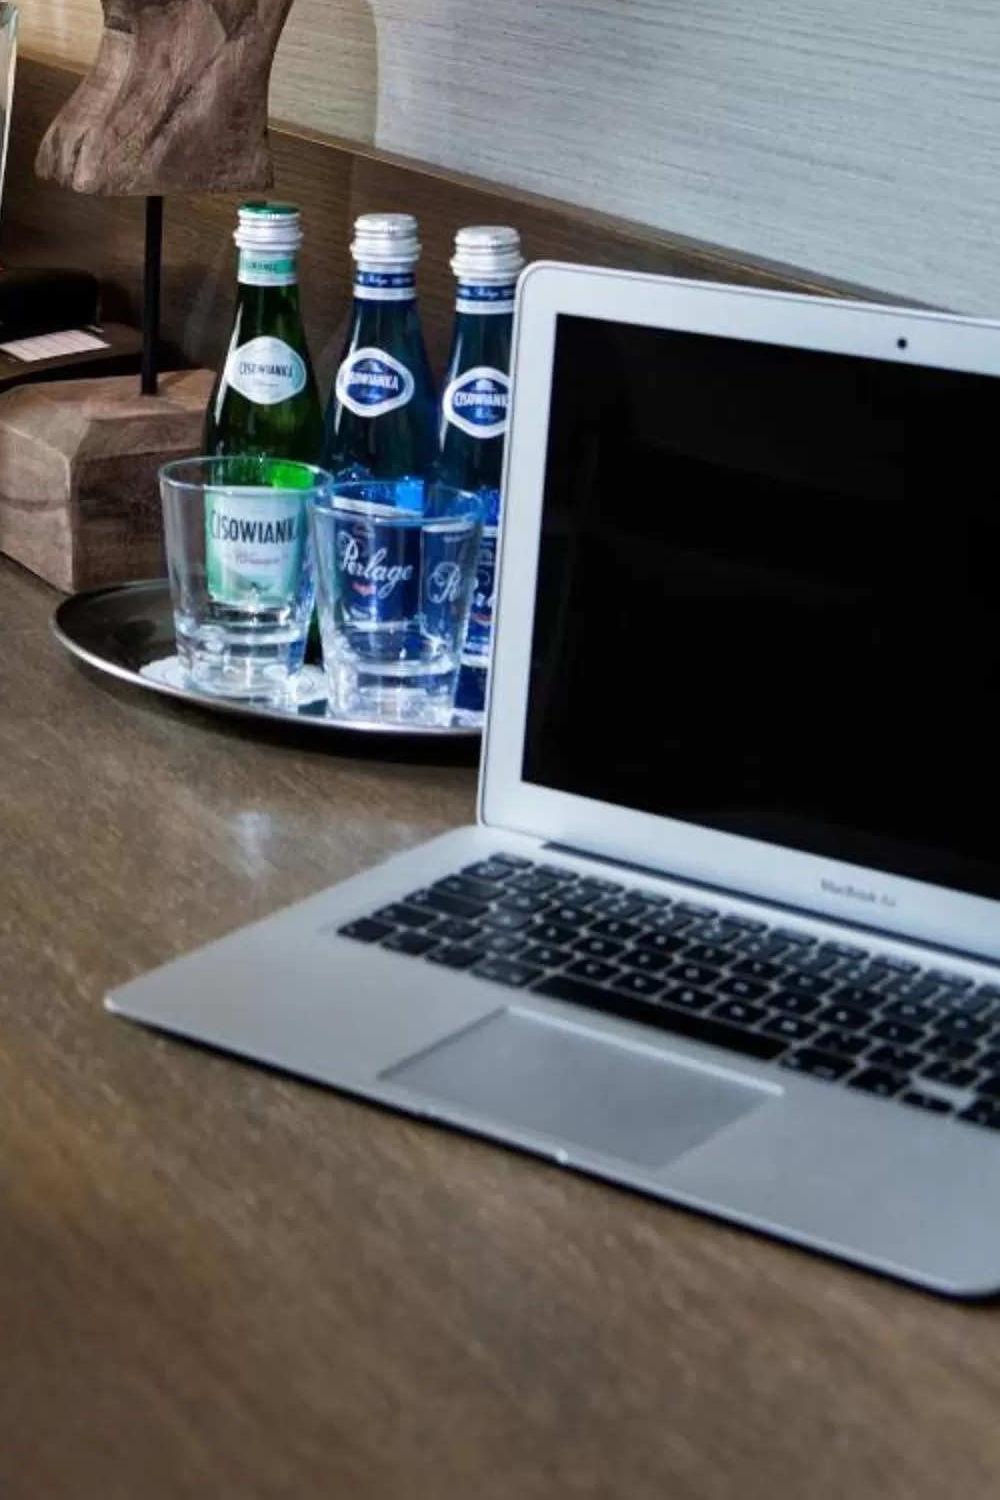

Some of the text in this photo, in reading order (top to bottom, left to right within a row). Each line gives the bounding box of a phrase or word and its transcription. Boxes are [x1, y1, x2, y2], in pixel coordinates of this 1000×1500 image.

[454, 391, 509, 409] CISOWIANK
[210, 510, 299, 545] CISOWIANK
[337, 531, 414, 599] Perlage
